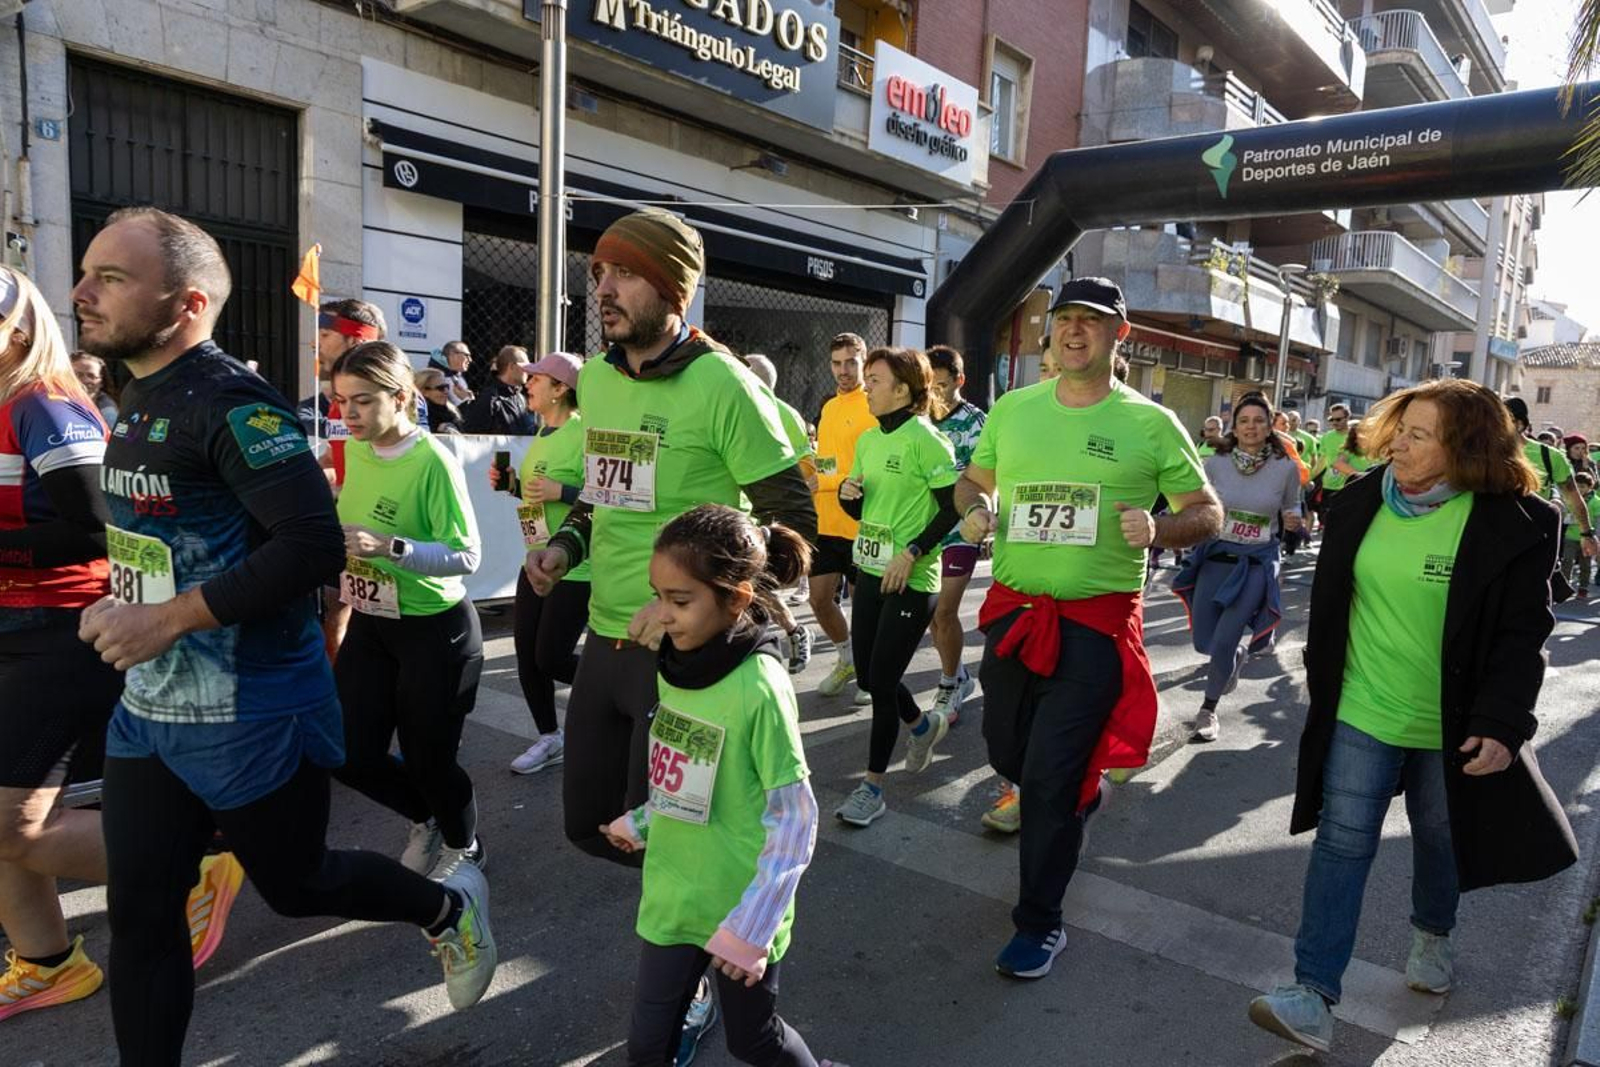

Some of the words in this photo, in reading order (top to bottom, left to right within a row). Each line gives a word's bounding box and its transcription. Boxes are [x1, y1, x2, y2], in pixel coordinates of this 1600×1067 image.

[629, 1, 745, 69] Triángulo
[747, 46, 801, 92] Legal
[686, 0, 828, 62] ADOS
[42, 120, 55, 139] 6
[886, 112, 928, 146] diseño
[928, 134, 968, 161] gráfico
[1243, 143, 1322, 164] Patronato
[1327, 130, 1411, 153] Municipal
[1418, 128, 1442, 143] de
[1242, 163, 1316, 182] Deportes
[1321, 157, 1342, 173] de
[1348, 152, 1391, 170] Jaén
[807, 256, 834, 279] PASOS
[107, 464, 172, 499] ANTÓN
[597, 457, 633, 491] 374
[1028, 504, 1076, 529] 573
[1232, 521, 1260, 538] 1039
[857, 537, 880, 558] 430
[113, 563, 143, 604] 381
[346, 574, 381, 602] 382
[650, 741, 689, 793] 965
